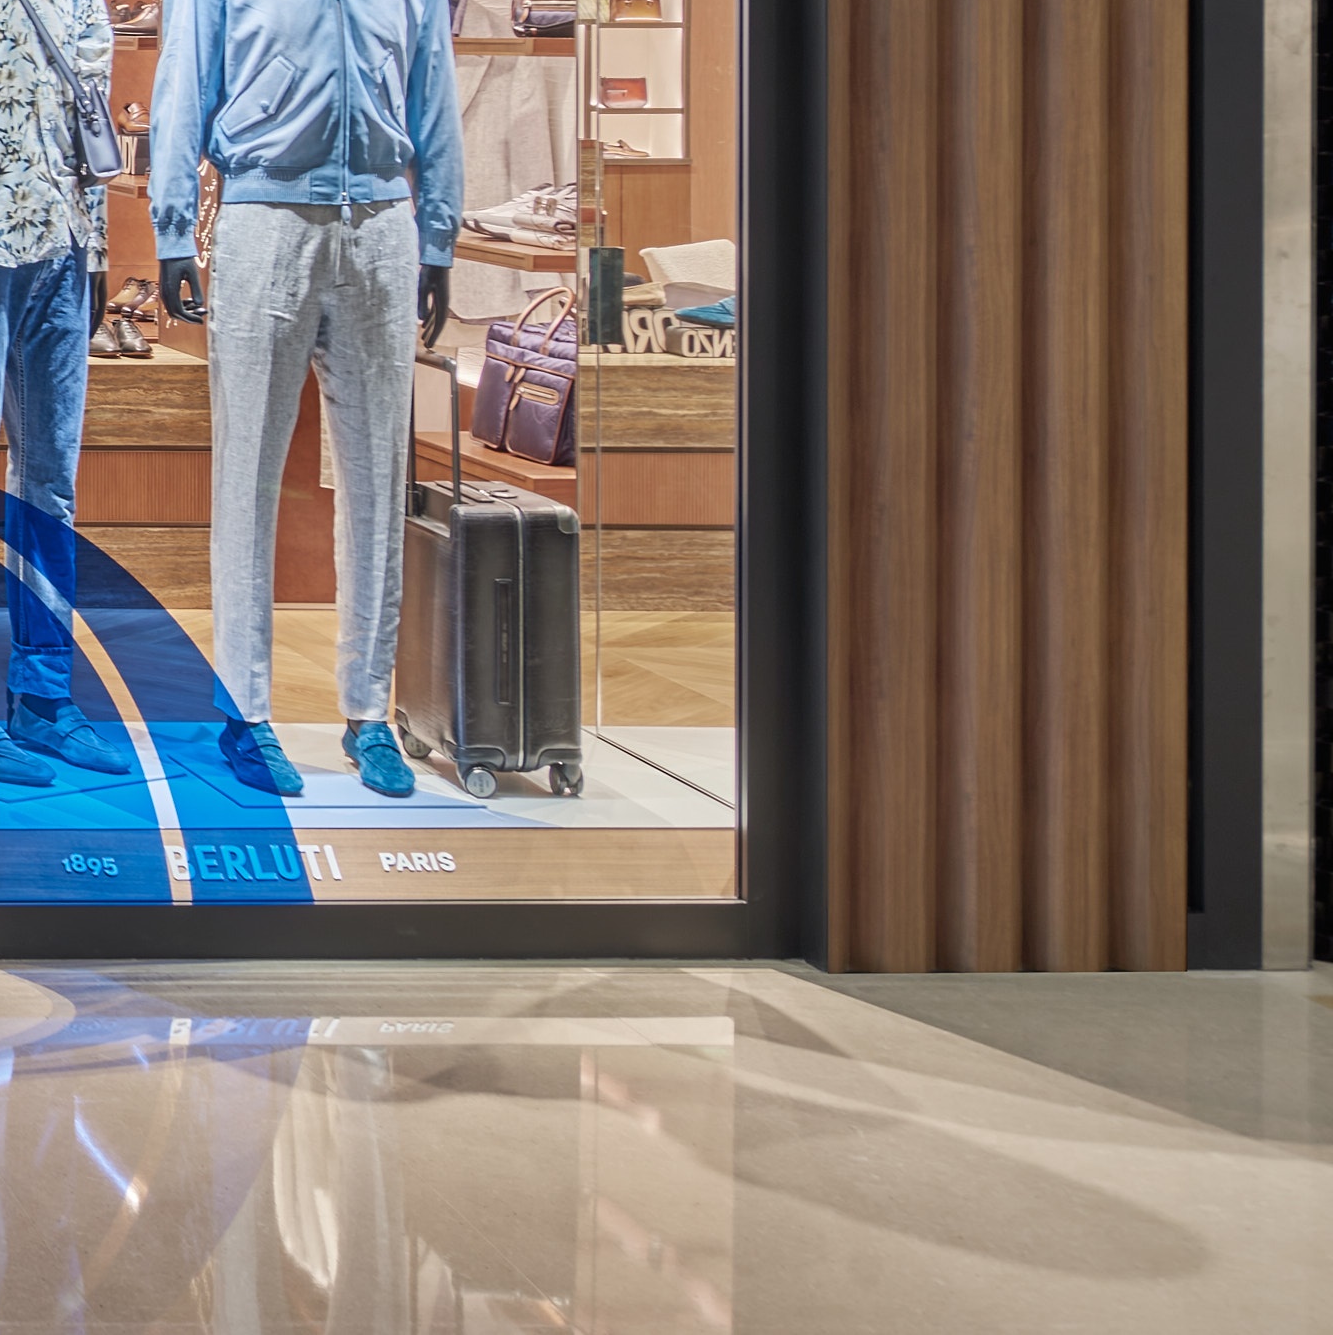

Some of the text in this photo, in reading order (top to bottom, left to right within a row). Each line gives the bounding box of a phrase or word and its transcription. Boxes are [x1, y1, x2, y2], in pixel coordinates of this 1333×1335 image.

[61, 844, 456, 881] 1895 BERLUTI PARIS
